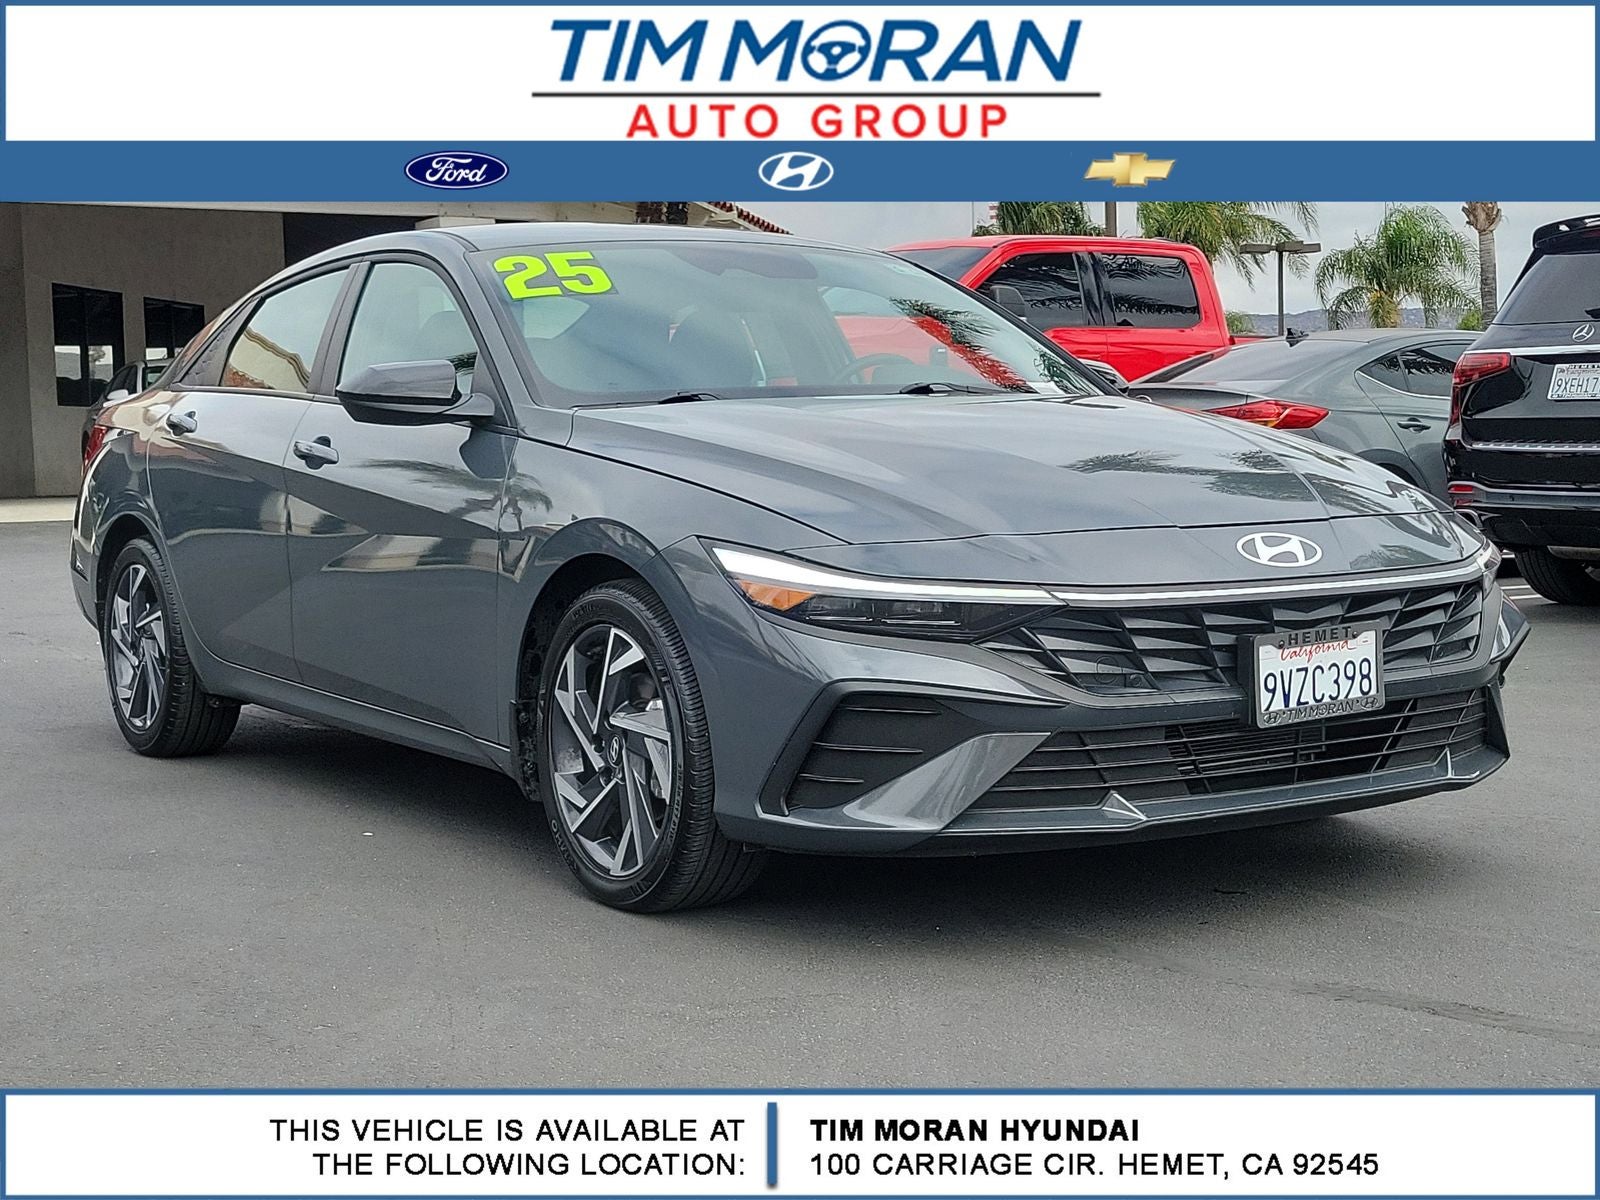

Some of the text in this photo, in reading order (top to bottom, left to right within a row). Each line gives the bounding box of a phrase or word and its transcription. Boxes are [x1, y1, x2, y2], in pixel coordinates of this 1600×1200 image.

[493, 251, 612, 300] 25
[1555, 377, 1600, 394] 9XEH17
[1288, 626, 1352, 645] HEMET
[1280, 639, 1357, 664] California
[1263, 657, 1372, 712] 9VZC398
[1288, 708, 1307, 722] TIM
